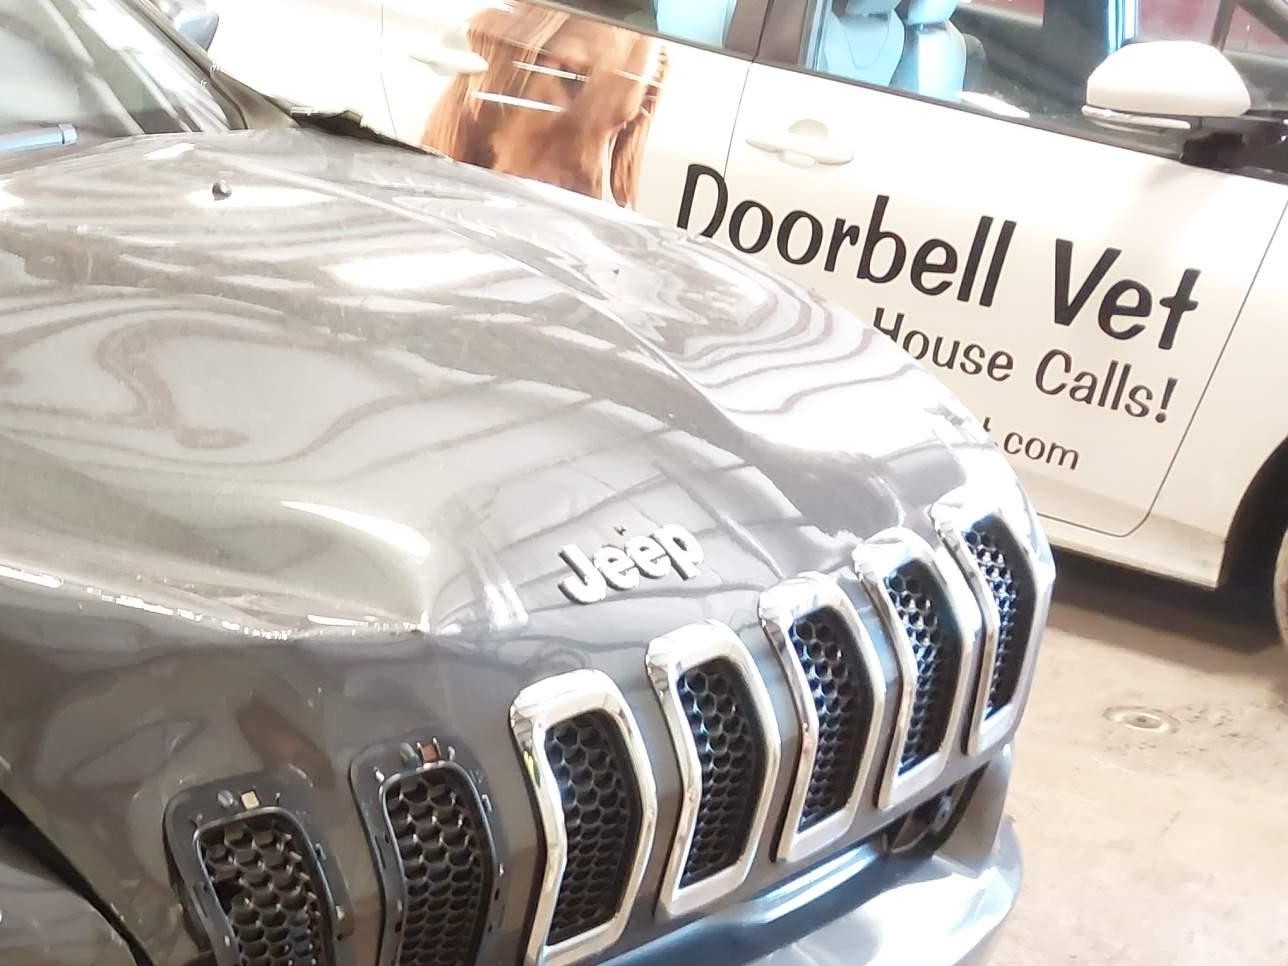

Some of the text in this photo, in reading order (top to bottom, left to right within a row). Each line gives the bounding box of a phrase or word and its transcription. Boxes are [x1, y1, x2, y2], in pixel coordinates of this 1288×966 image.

[676, 163, 1202, 350] Doorbell Vet
[872, 306, 1178, 424] House Calls!
[558, 524, 705, 604] Jeep
